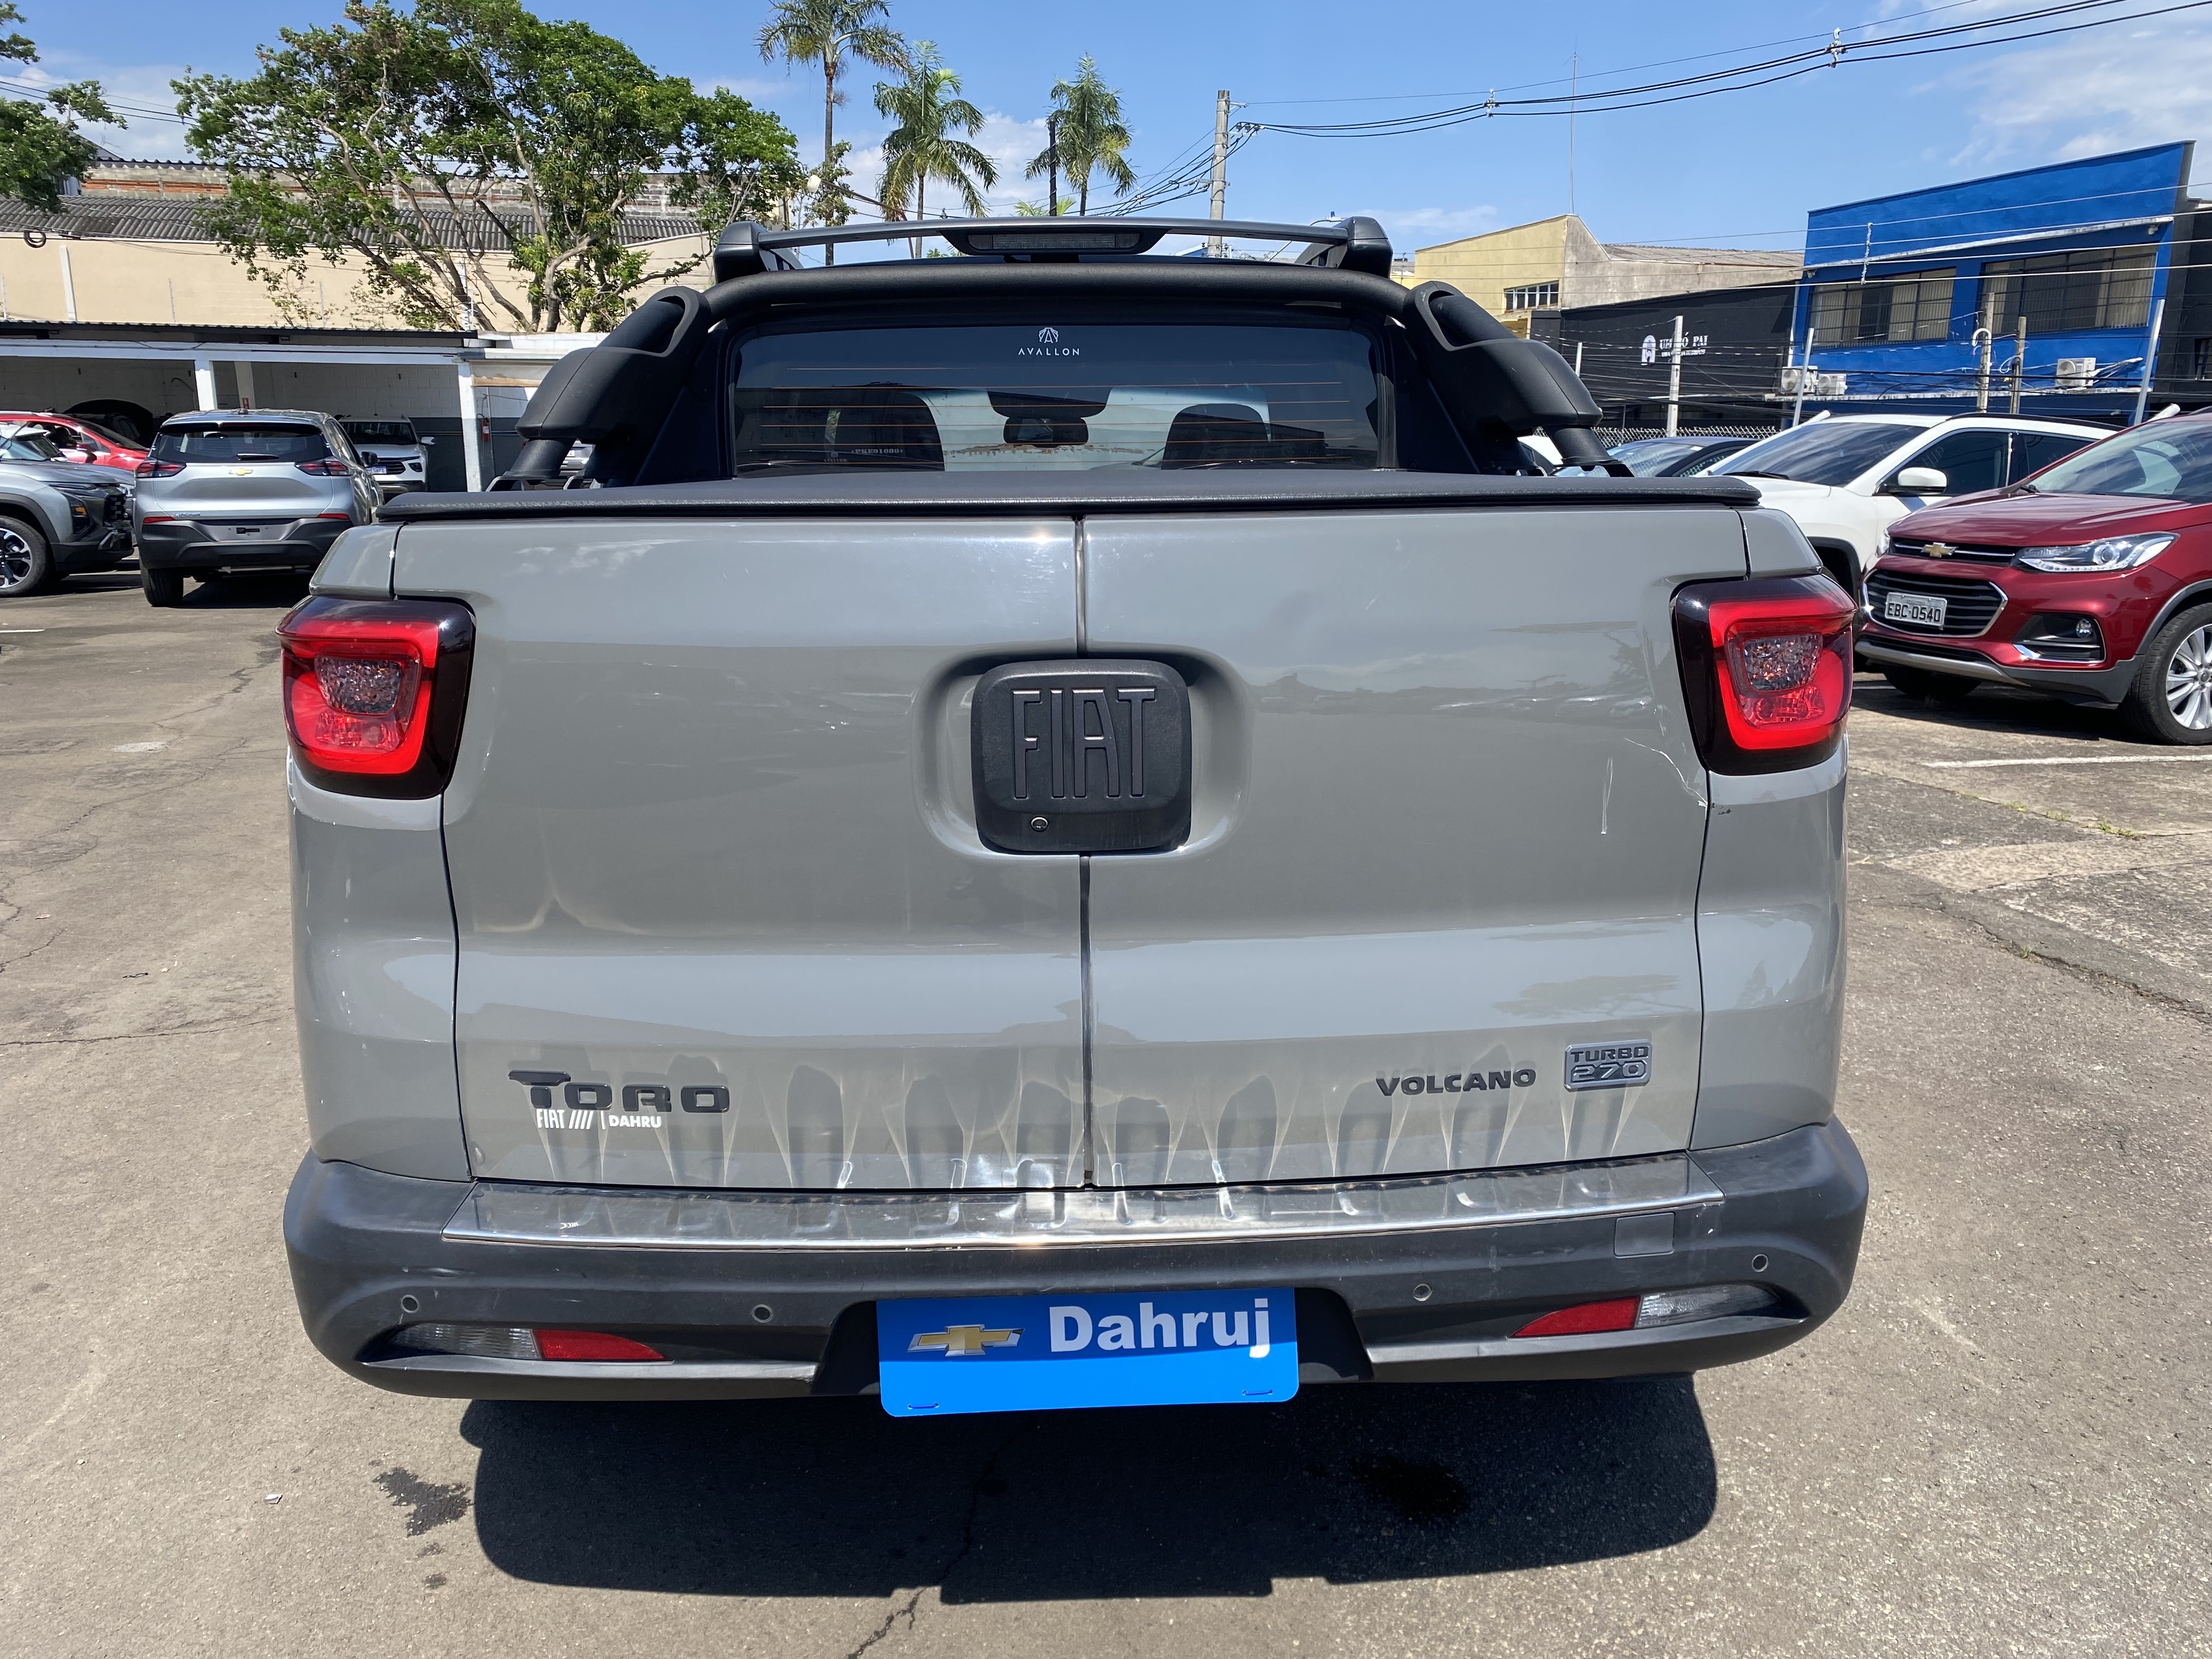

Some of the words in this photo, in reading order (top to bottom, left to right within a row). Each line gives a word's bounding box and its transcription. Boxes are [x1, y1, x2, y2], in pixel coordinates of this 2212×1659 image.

[1018, 347, 1080, 356] AVALLON
[1692, 335, 1708, 347] PAI
[1012, 688, 1156, 799] FIAT
[1570, 1046, 1649, 1063] TURBO
[1376, 1068, 1537, 1096] VOLCANO
[1572, 1060, 1648, 1083] 270
[508, 1070, 730, 1113] TORO
[536, 1108, 565, 1129] FIAT
[608, 1114, 662, 1128] DAHRU
[1049, 1297, 1269, 1359] Dahruj
